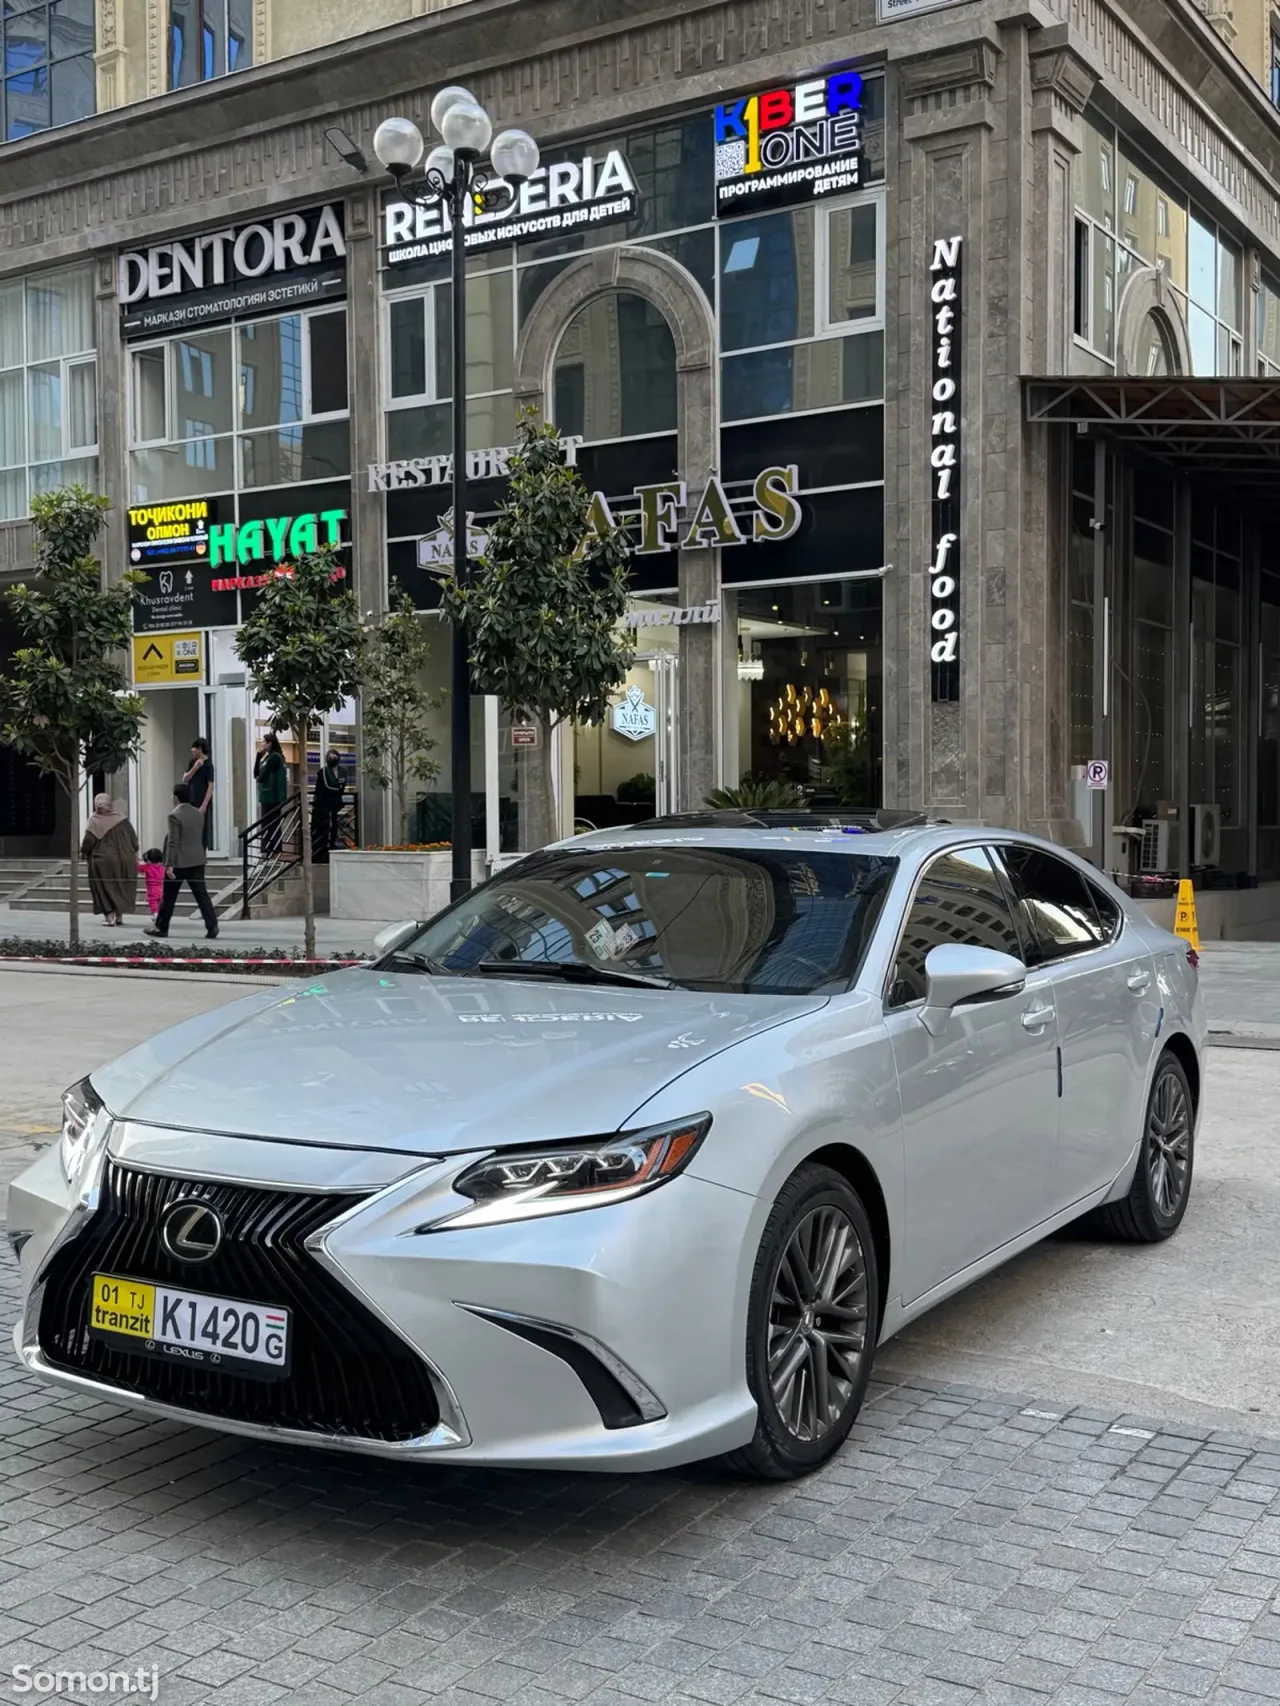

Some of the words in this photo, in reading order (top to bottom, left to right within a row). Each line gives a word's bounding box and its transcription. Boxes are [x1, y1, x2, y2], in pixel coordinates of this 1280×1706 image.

[760, 112, 860, 169] ONE
[719, 157, 858, 199] ПРОГРАММИРОВАНИЕ
[813, 172, 859, 194] ДЕТЯМ
[388, 244, 428, 263] ШКОЛА
[429, 227, 496, 254] ЦИФОВЫХ
[497, 215, 561, 239] ИСКУССТВ
[562, 208, 588, 228] ДЛЯ
[589, 196, 631, 222] ДЕТЕЙ
[119, 205, 347, 304] DENTORA
[143, 308, 186, 327] МАРКАЗИ
[187, 290, 267, 318] СТОМАТОЛОГИЯИ
[930, 235, 963, 499] National
[572, 464, 802, 561] AFAS
[209, 509, 348, 569] HAYAT
[431, 540, 478, 559] NAS
[928, 533, 958, 663] food
[622, 713, 649, 726] NAFAS
[101, 1283, 119, 1304] 01
[130, 1291, 145, 1310] TJ
[95, 1305, 151, 1334] tranzit
[161, 1295, 260, 1354] K1420
[163, 1345, 204, 1361] LEXUS
[265, 1333, 283, 1359] G
